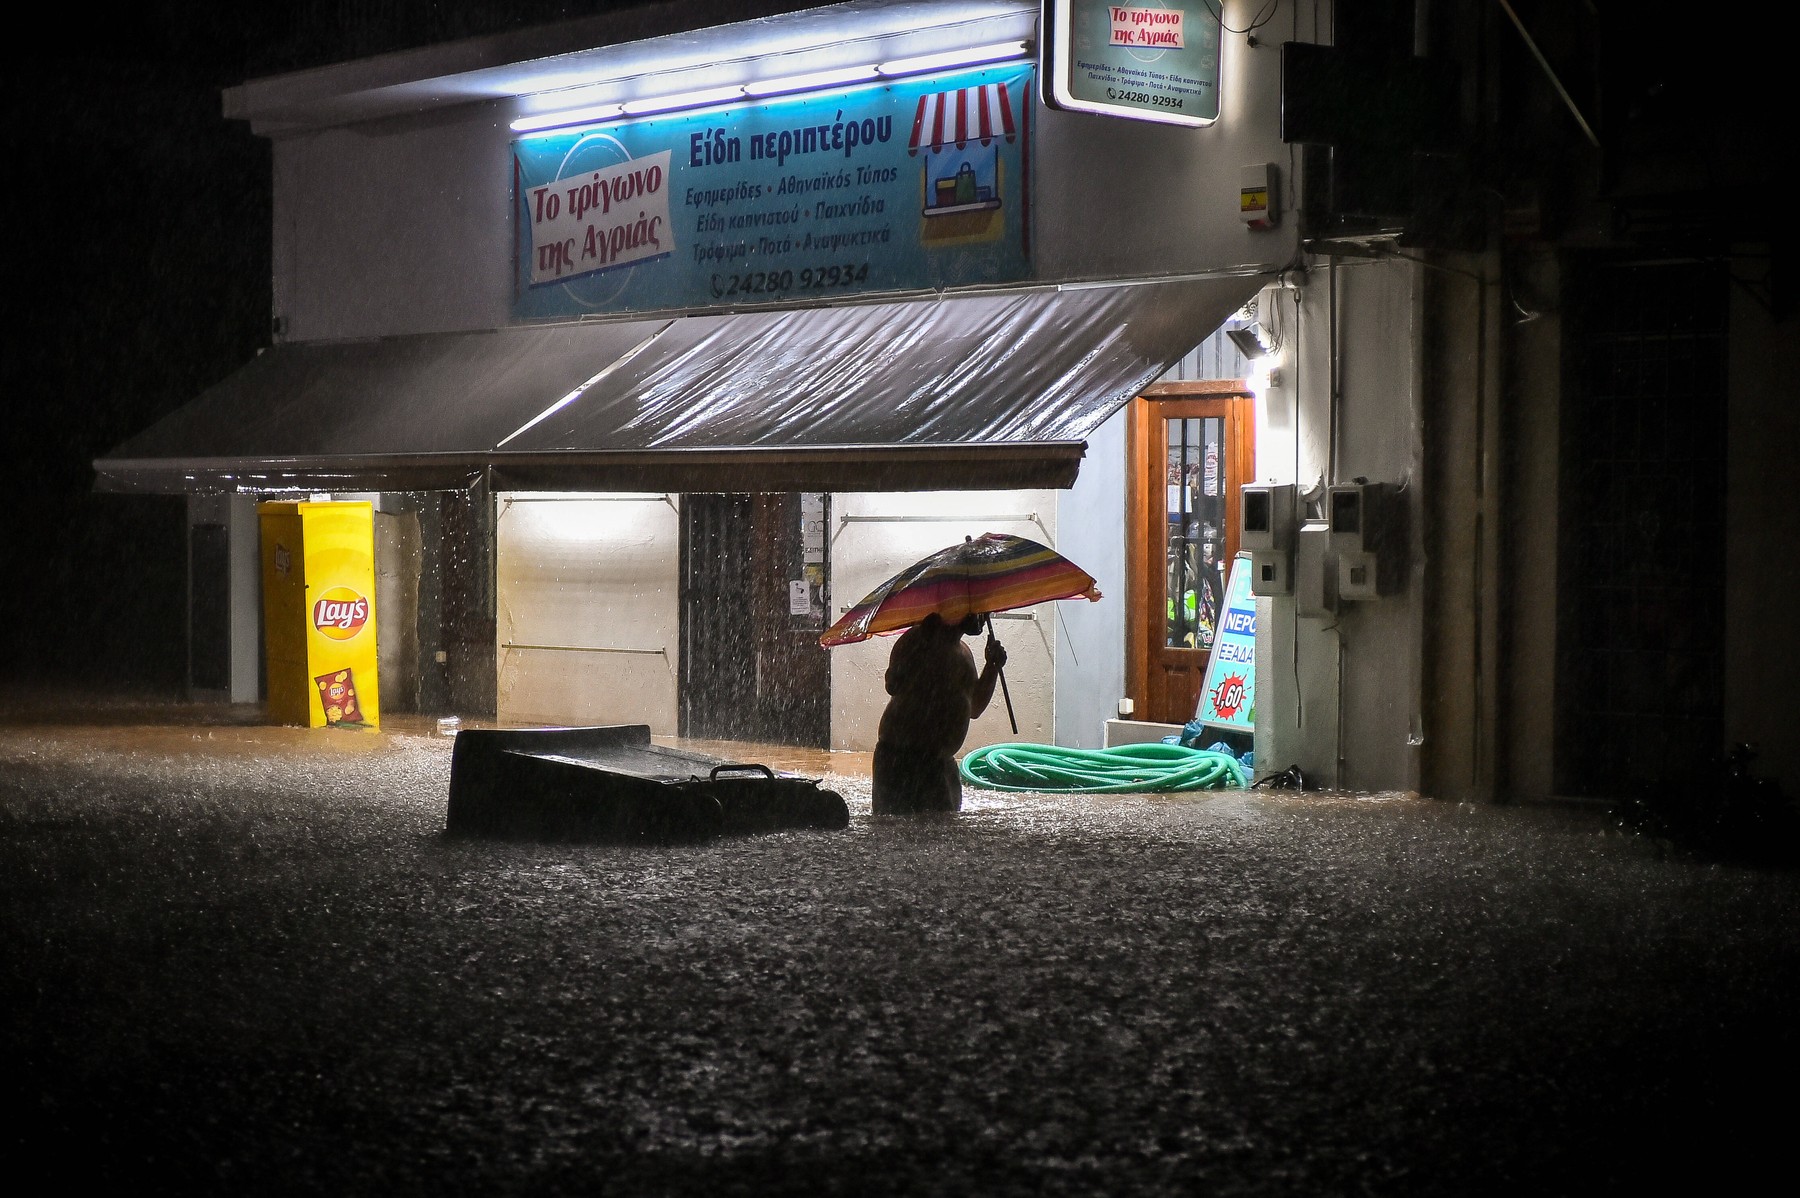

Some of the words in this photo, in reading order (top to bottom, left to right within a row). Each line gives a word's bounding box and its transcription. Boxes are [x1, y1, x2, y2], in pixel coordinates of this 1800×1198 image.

[1112, 7, 1127, 22] Το
[1131, 9, 1180, 26] τρίγωνο
[1114, 29, 1135, 44] της
[1137, 28, 1179, 46] Αγριάς
[1077, 60, 1111, 72] Εφημερίδες
[1117, 66, 1147, 78] Αθηναϊκός
[1149, 71, 1165, 80] Τύπος
[1169, 74, 1182, 83] Είδη
[1183, 78, 1212, 87] καπνιστού
[1088, 72, 1116, 82] Παιχνίδια
[1121, 77, 1145, 87] Τρόφιμα
[1149, 81, 1163, 89] Ποτά
[1167, 84, 1201, 95] Αναψυκτικά
[1118, 90, 1149, 103] 24280
[1152, 95, 1183, 108] 92934
[690, 127, 741, 167] Είδη
[750, 109, 892, 167] περιπτέρου
[534, 187, 560, 223] Το
[567, 165, 662, 220] τρίγωνο
[685, 181, 762, 208] Εφημερίδες
[777, 168, 851, 196] Αθηναϊκός
[856, 165, 898, 184] Τύπος
[697, 212, 725, 233] Είδη
[729, 203, 799, 229] καπνιστού
[815, 196, 885, 220] Παιχνίδια
[537, 238, 575, 275] της
[581, 211, 662, 264] Αγριάς
[693, 242, 746, 264] Τρόφιμα
[758, 233, 791, 256] Ποτά
[802, 223, 890, 252] Αναψυκτικά
[726, 269, 793, 296] 24280
[800, 262, 869, 290] 92934
[317, 599, 366, 629] Lay's
[1218, 643, 1254, 663] ΕΞΑΔΑ
[1216, 682, 1243, 711] 1,60
